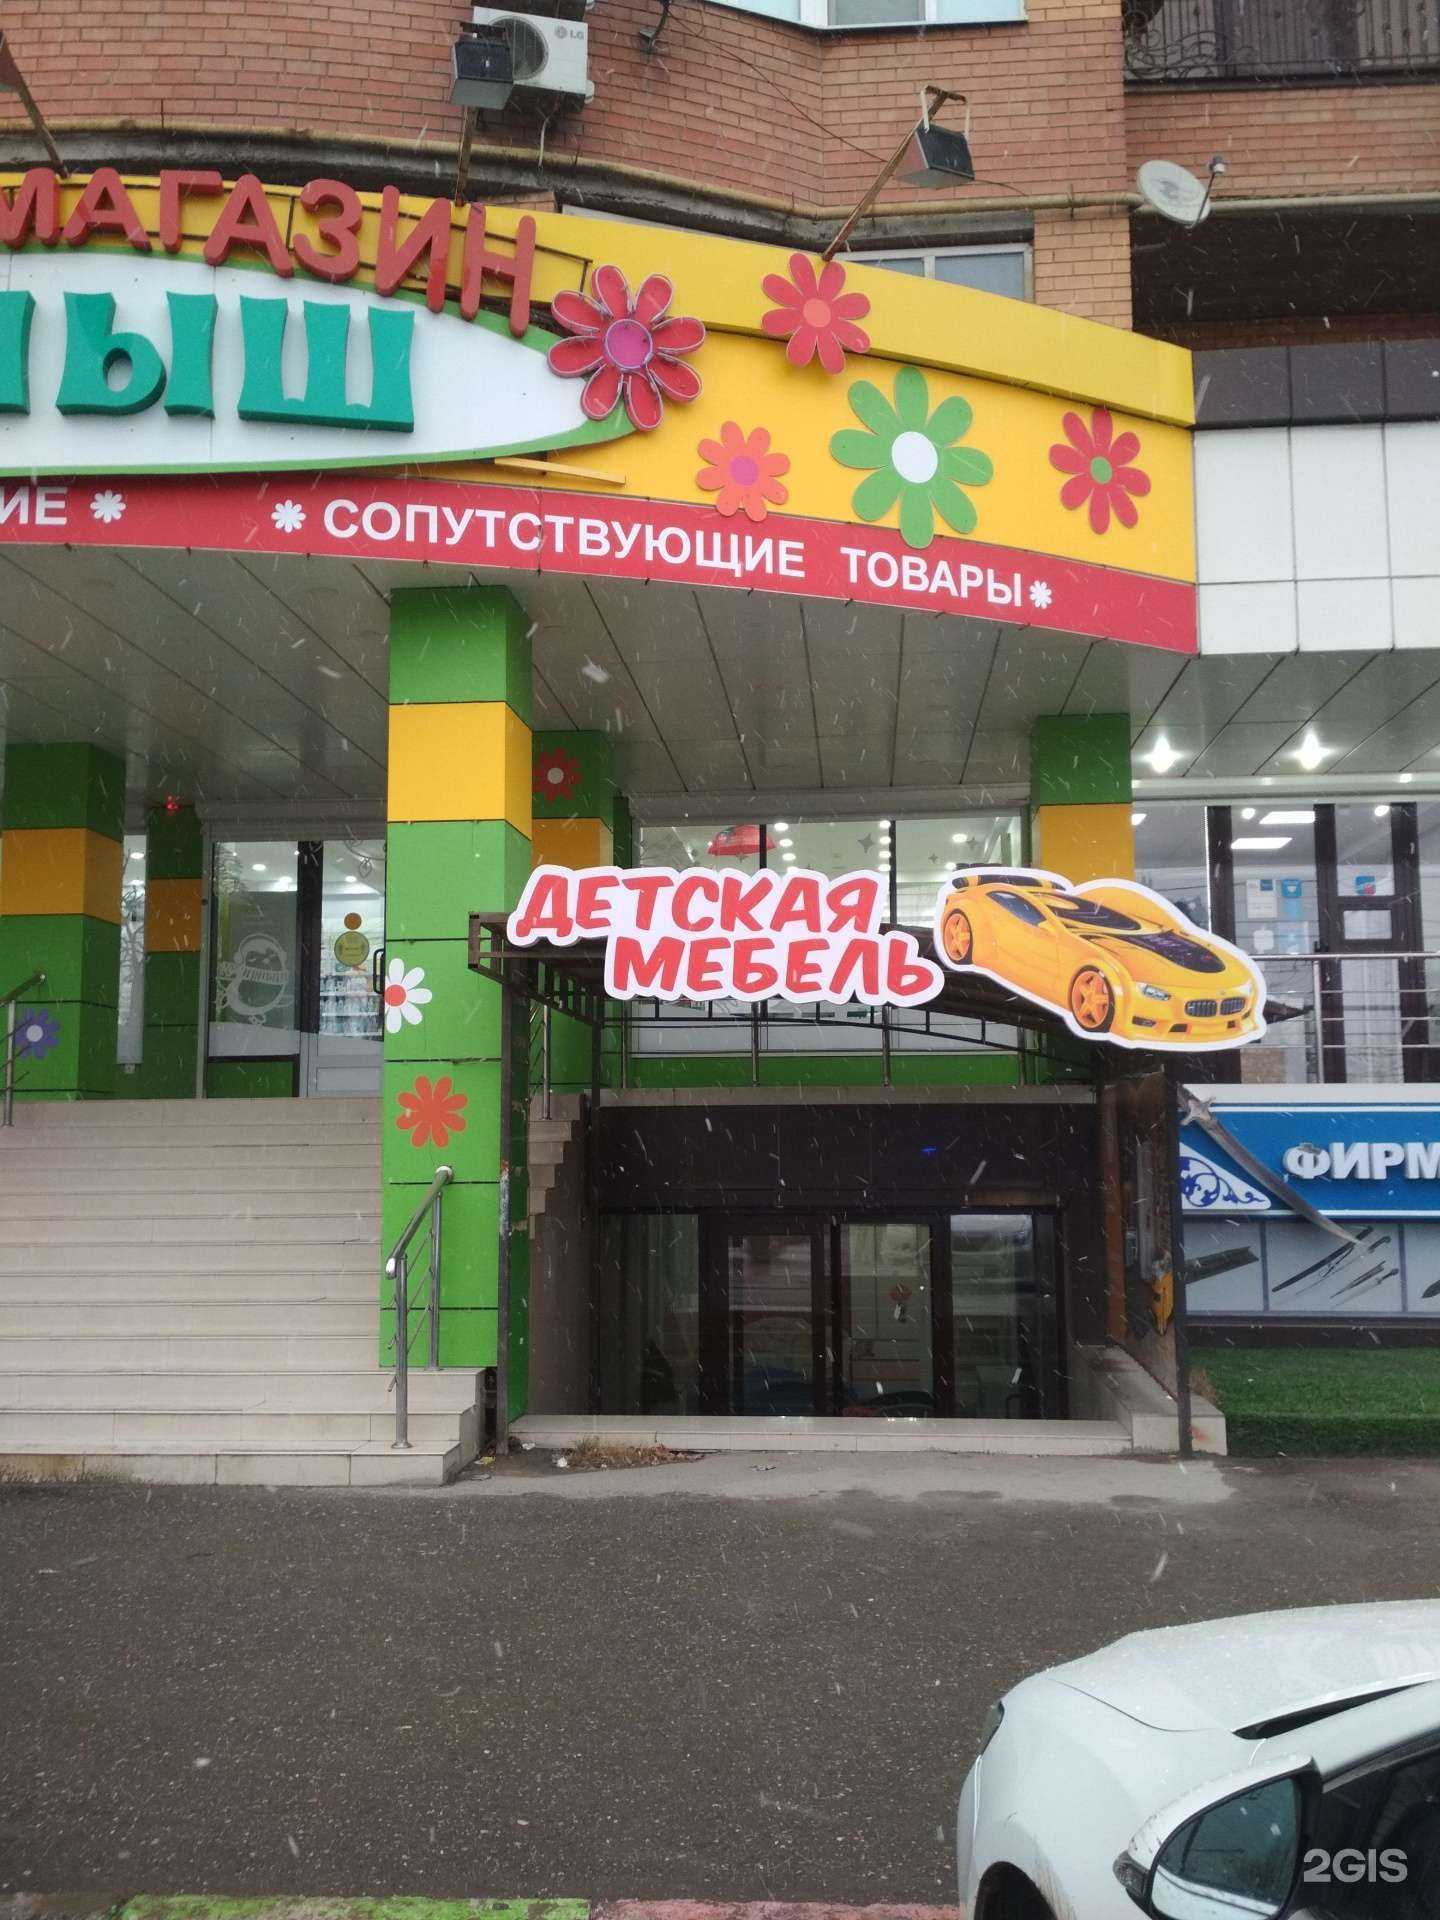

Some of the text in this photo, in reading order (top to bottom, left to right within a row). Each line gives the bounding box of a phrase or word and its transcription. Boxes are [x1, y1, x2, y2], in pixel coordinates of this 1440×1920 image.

[0, 167, 536, 338] МАГАЗИН
[323, 499, 1022, 607] СОПУТСТВУЮЩИЕ ТОВАРЫ
[518, 875, 880, 938] ДЕТСКАЯ
[613, 935, 934, 997] МЕБЕЛЬ
